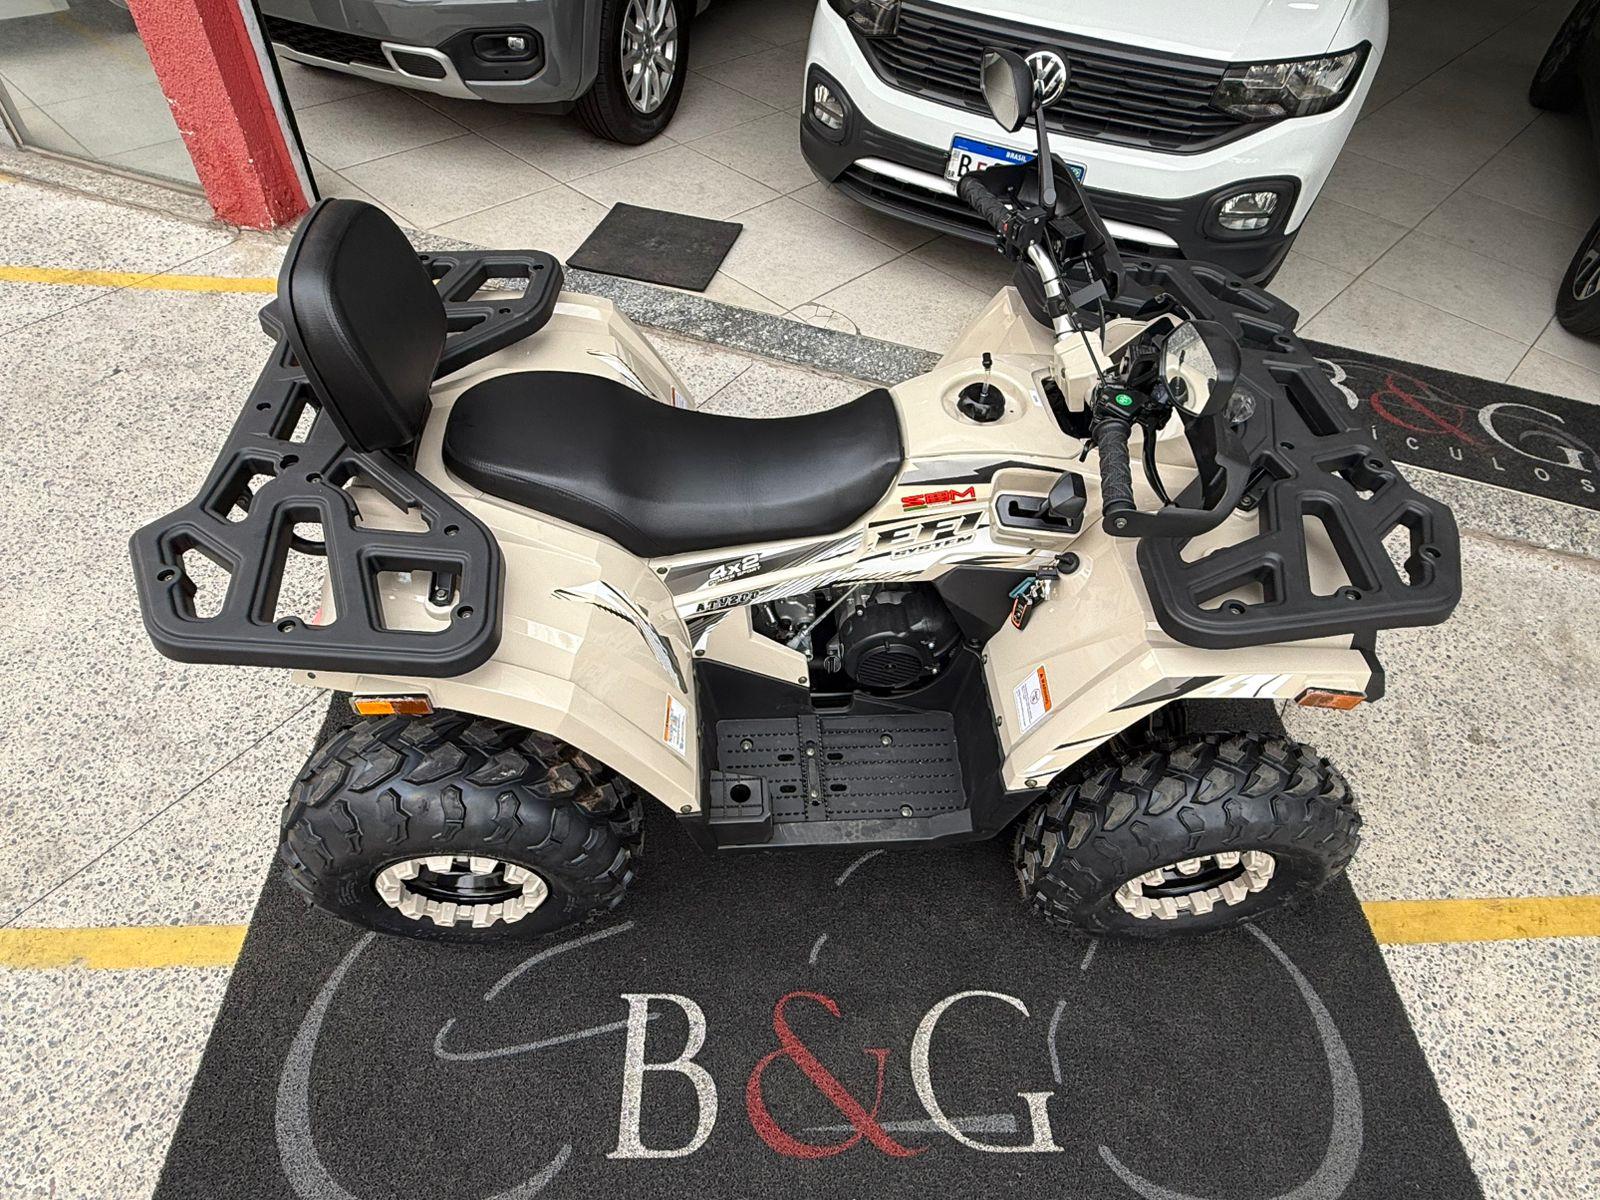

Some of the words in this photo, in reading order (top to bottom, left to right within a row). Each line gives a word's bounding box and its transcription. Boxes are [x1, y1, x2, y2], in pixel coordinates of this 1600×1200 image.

[1005, 151, 1028, 164] BRASIL
[1371, 424, 1596, 493] ÍCULOS
[872, 511, 985, 551] EFI
[892, 533, 974, 559] SYSTEM
[709, 554, 761, 579] 4x2
[737, 565, 761, 577] SPORT
[696, 590, 760, 613] ATV200
[606, 990, 1065, 1159] B&G
